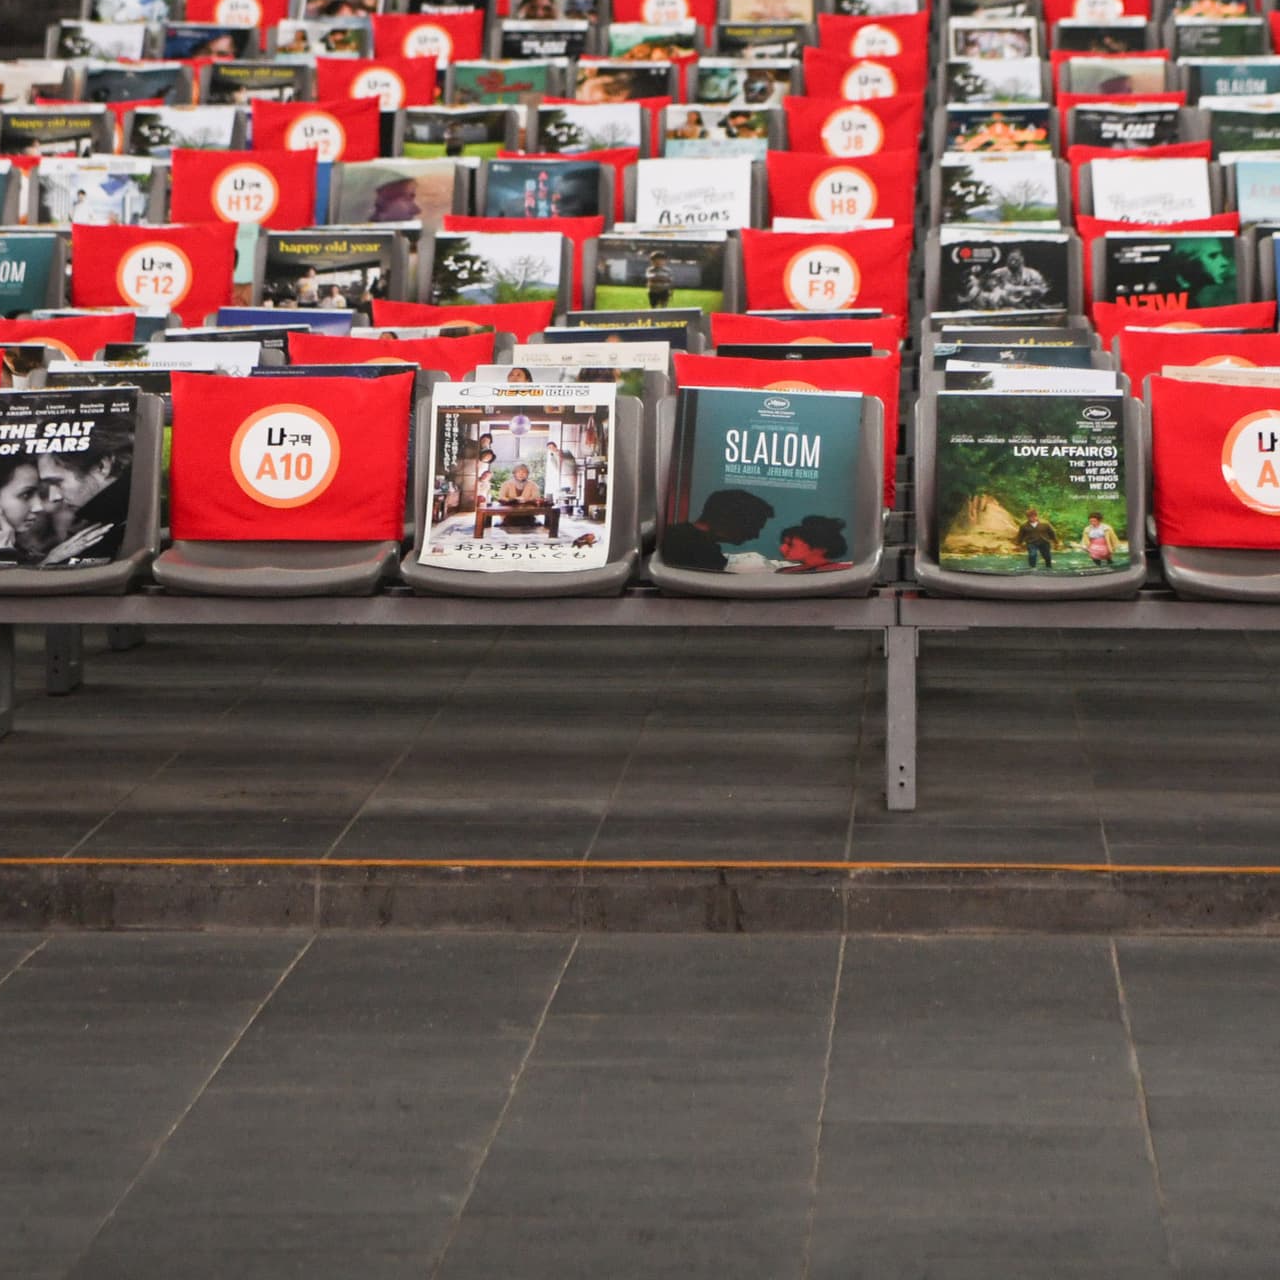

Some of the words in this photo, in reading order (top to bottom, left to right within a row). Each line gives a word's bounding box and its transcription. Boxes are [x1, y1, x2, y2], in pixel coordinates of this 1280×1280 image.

[227, 194, 263, 212] H12
[831, 197, 857, 216] H8
[279, 240, 322, 254] happy
[325, 239, 348, 253] old
[350, 242, 381, 254] year
[135, 275, 174, 295] F12
[43, 421, 96, 438] SALT
[266, 426, 312, 447] 나구역
[25, 437, 91, 455] TEARS
[724, 428, 821, 469] SLALOM
[1013, 446, 1049, 457] LOVE
[1051, 445, 1119, 459] AFFAIR(S)
[255, 452, 313, 482] A10
